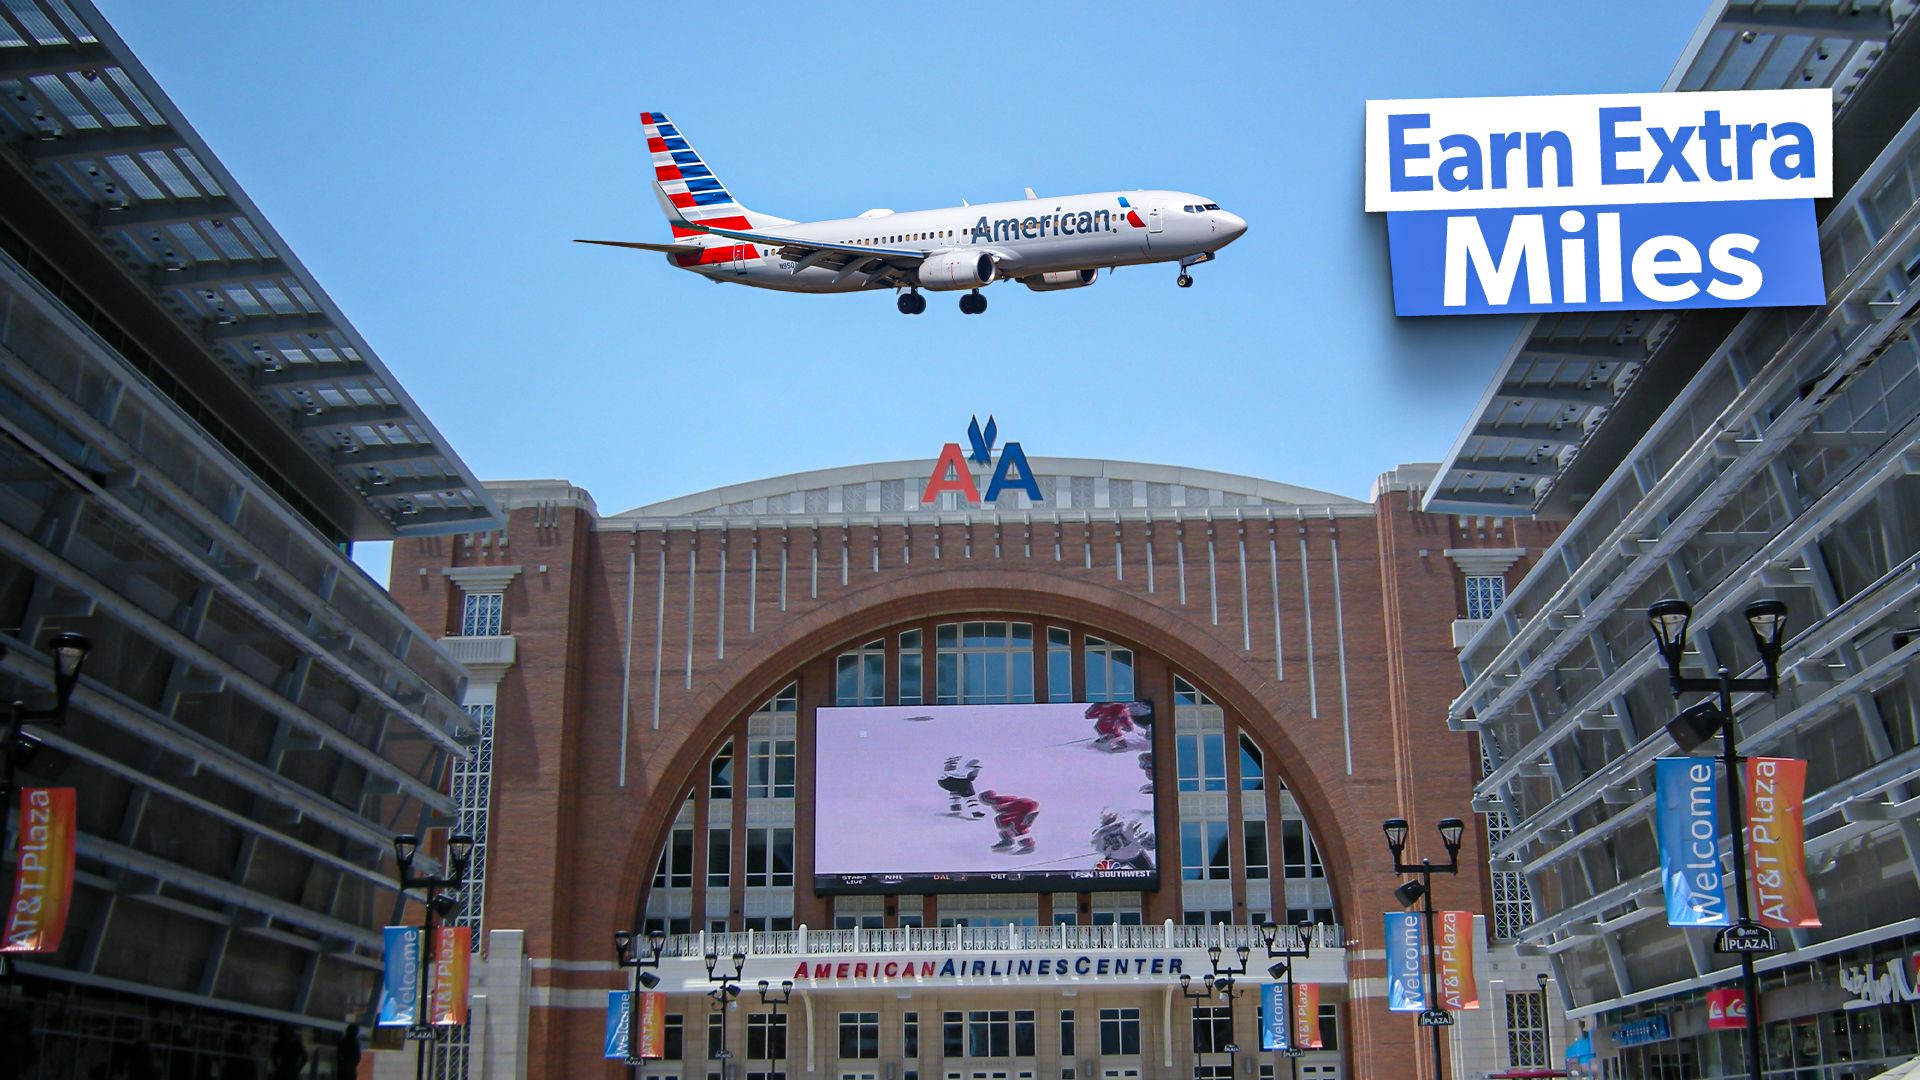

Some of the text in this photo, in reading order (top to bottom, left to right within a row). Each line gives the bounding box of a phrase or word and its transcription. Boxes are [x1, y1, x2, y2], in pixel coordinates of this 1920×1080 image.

[971, 207, 1110, 244] American
[9, 790, 50, 948] AT&T Plaza
[1687, 764, 1723, 924] Welcome
[1751, 761, 1790, 923] AT&T Plaza
[395, 930, 417, 1023] Welcome
[439, 928, 455, 976] Plaza
[1403, 916, 1422, 1008] Welcome
[1442, 913, 1461, 1007] AT&T Plaza
[1729, 938, 1769, 949] PLAZA
[616, 993, 630, 1057] Welcome
[1272, 985, 1286, 1048] Welcome
[1298, 984, 1308, 1017] Plaza
